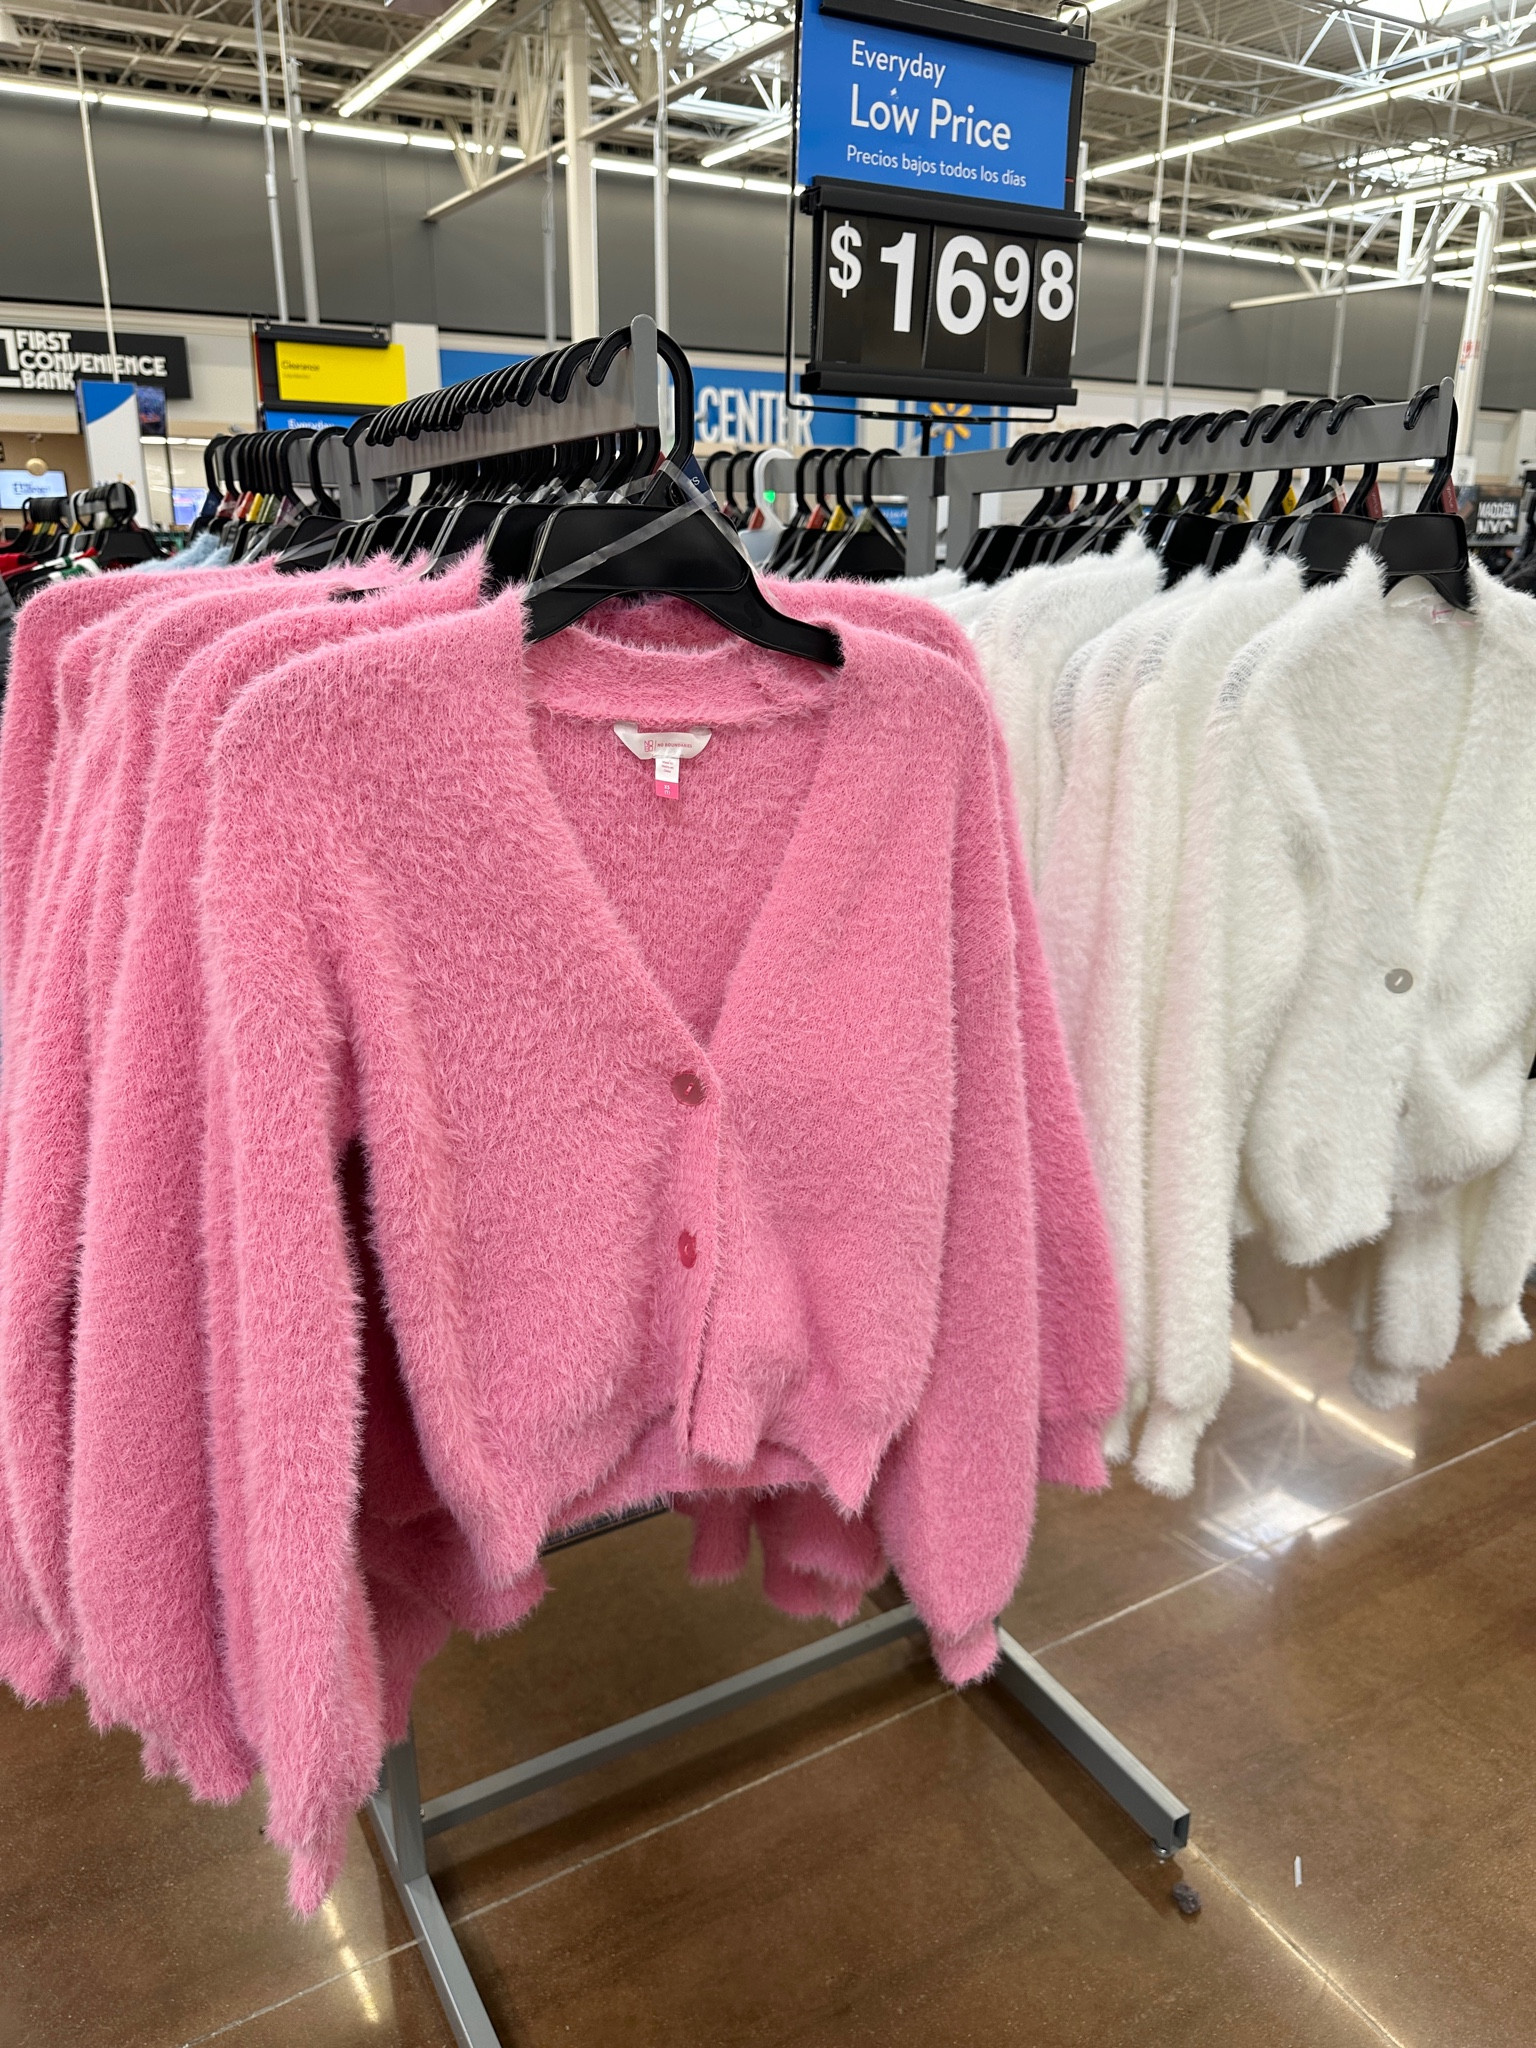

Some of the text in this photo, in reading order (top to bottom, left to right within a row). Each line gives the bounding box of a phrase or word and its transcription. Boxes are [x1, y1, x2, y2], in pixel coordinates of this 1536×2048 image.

[851, 39, 947, 89] Everyday
[850, 82, 1013, 151] Low Price
[846, 144, 1027, 188] Precios bajos todos los días
[16, 329, 72, 351] FIRST
[19, 349, 168, 377] CONVENIENCE
[20, 369, 77, 391] BANK
[697, 386, 815, 446] CENTER
